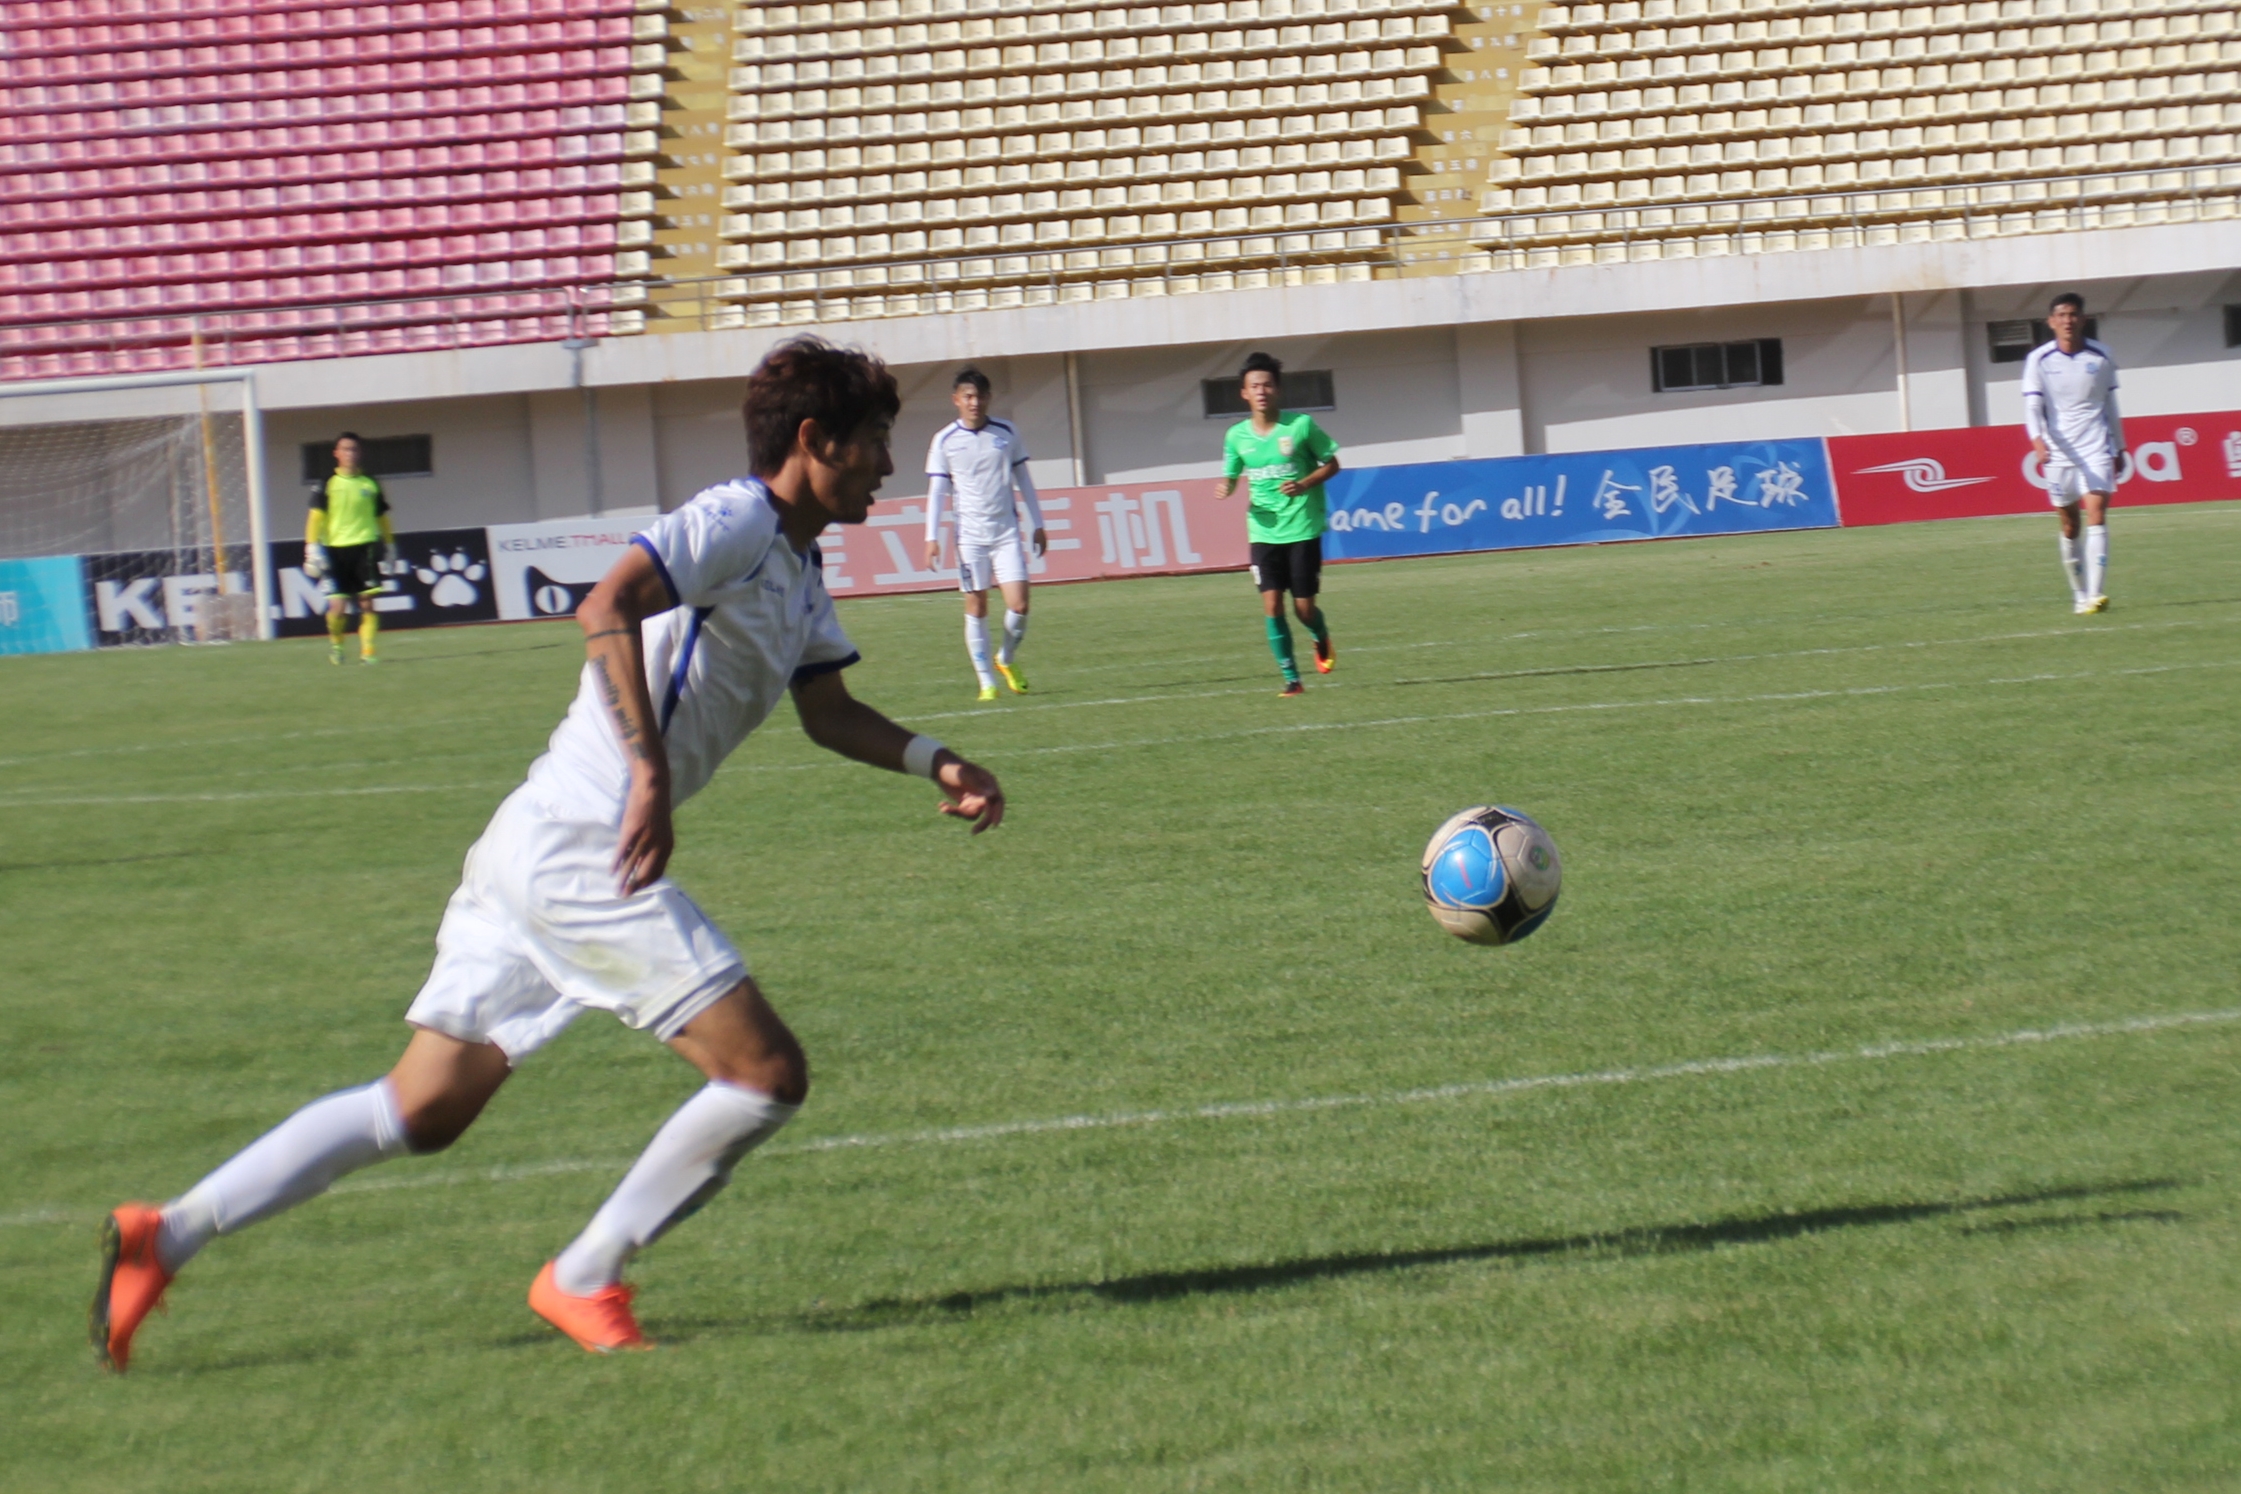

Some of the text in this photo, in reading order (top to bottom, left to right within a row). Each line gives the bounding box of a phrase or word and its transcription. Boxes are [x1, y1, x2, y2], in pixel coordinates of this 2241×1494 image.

[1329, 473, 1567, 534] ame for all!
[95, 559, 415, 632] KEM
